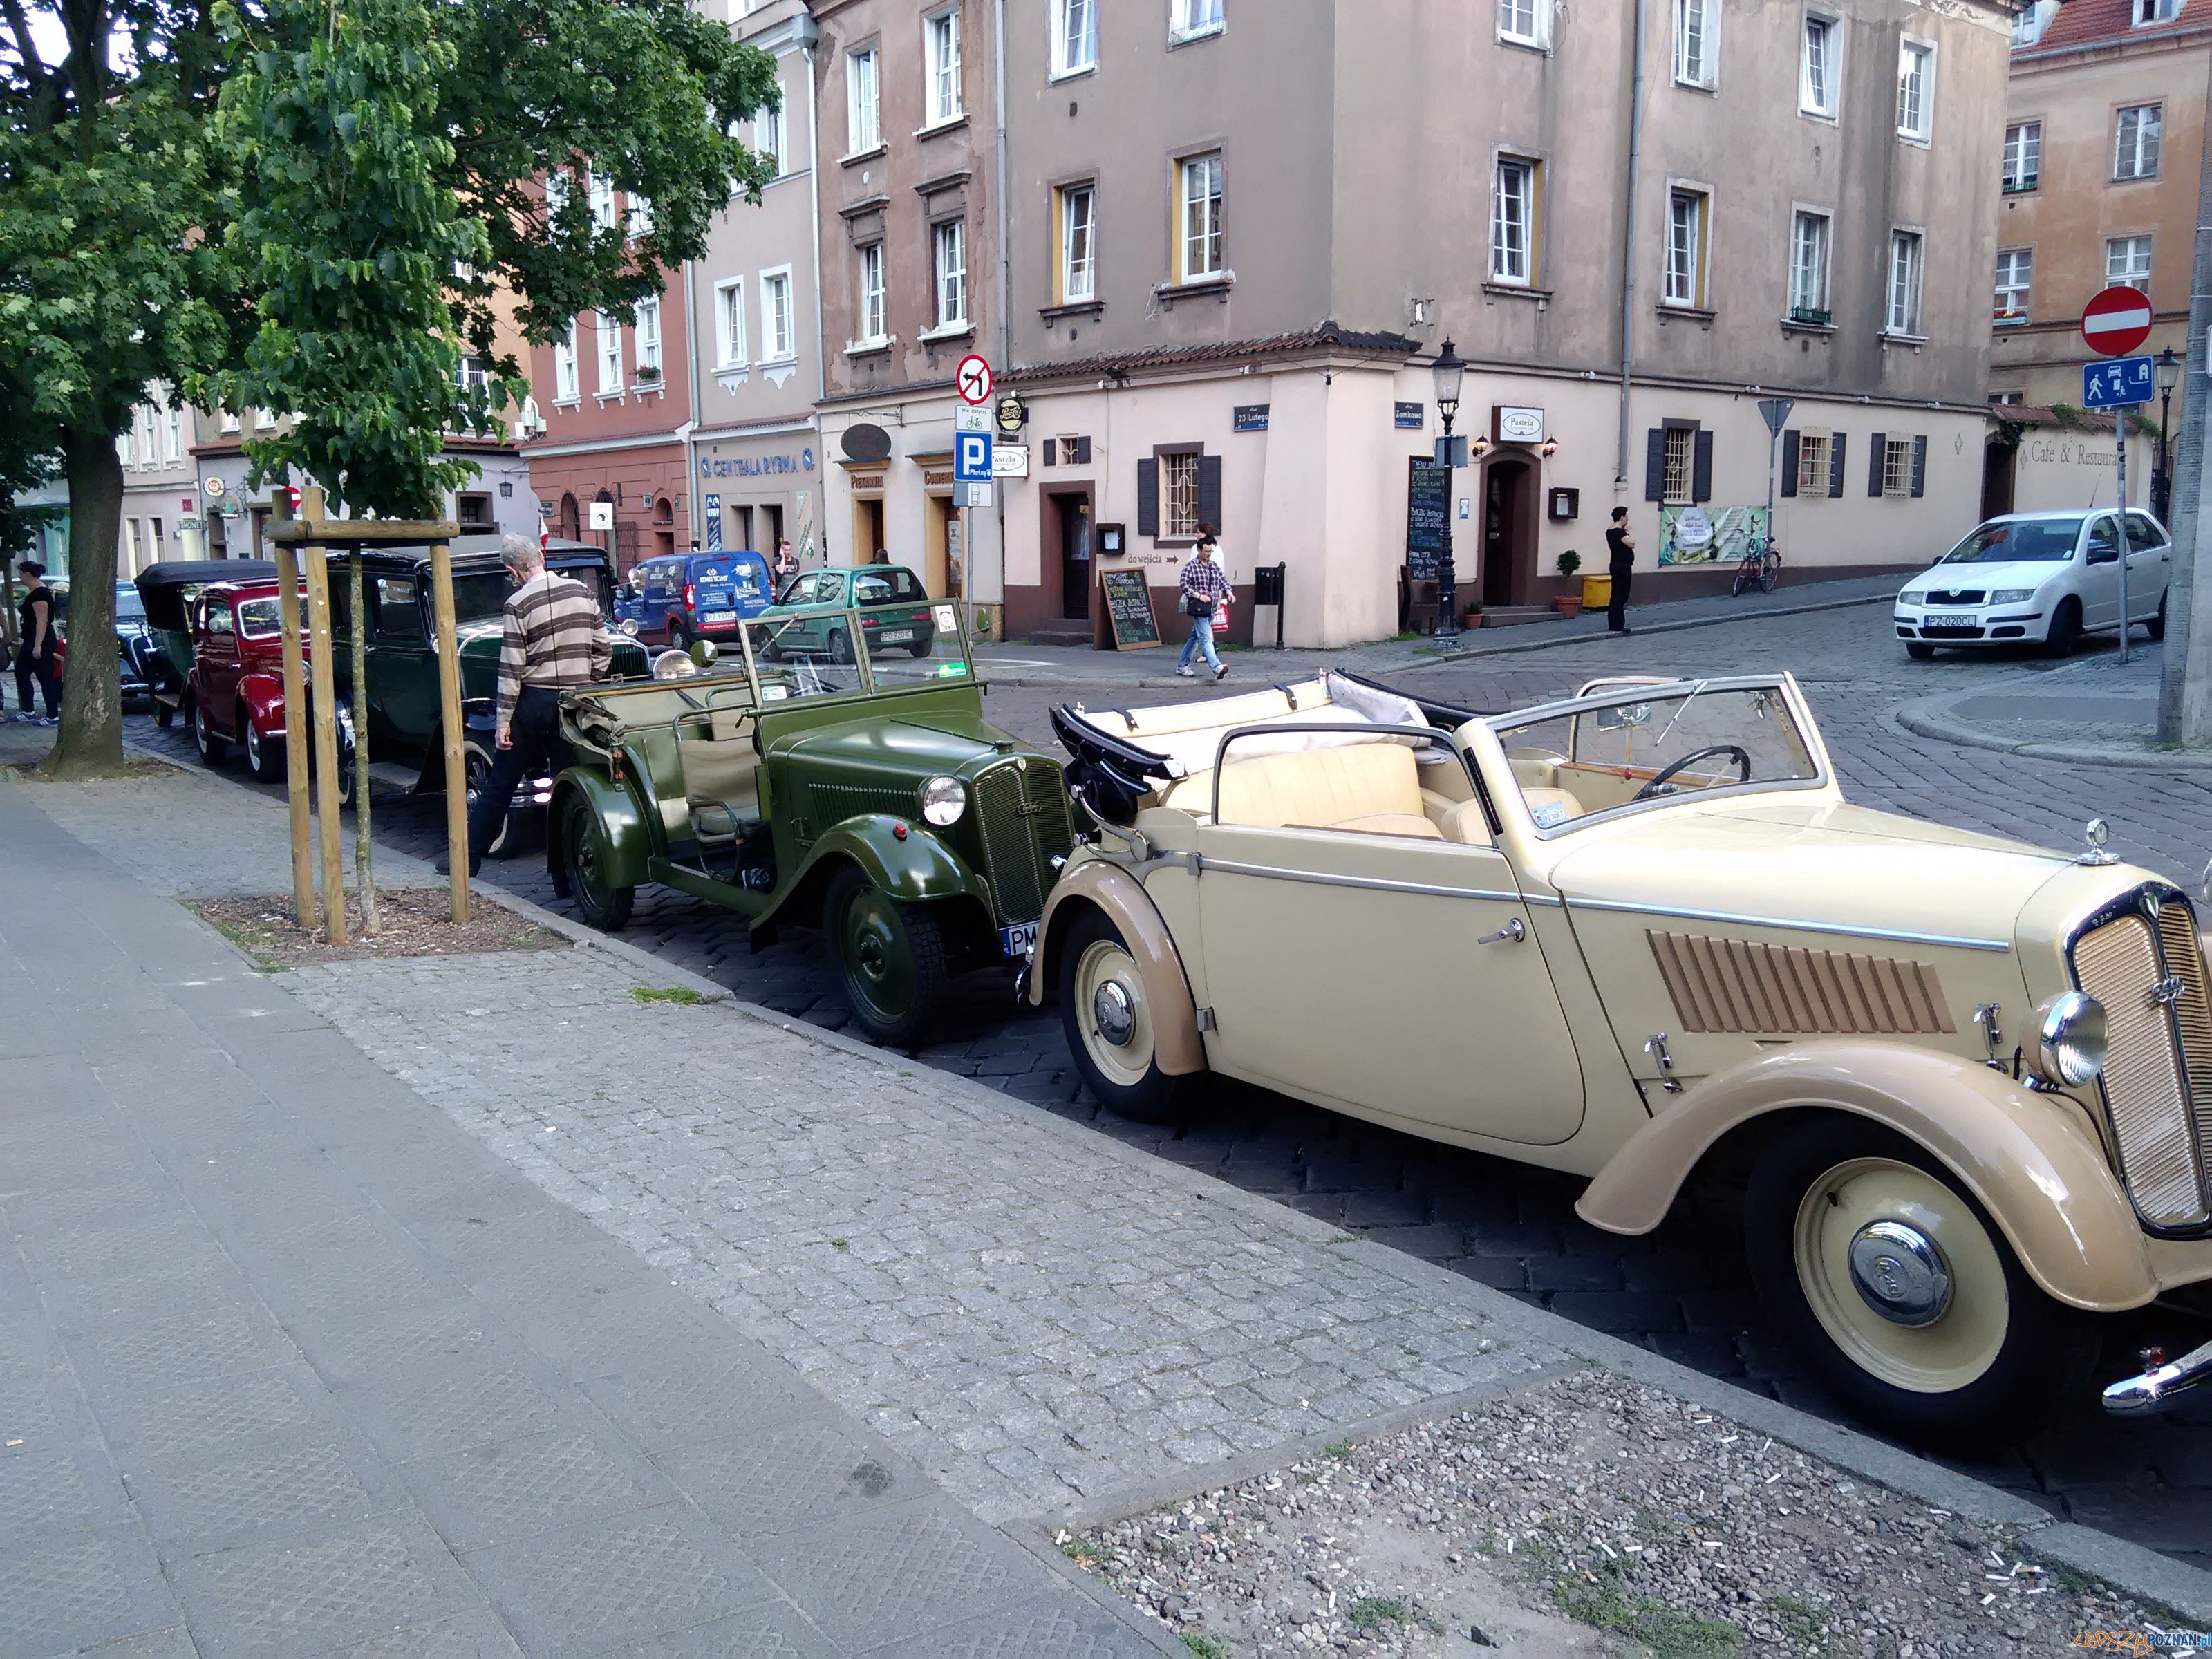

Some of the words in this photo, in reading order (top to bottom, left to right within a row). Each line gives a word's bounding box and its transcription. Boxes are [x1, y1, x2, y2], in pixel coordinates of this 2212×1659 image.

[1238, 413, 1246, 422] 23
[1248, 413, 1268, 422] Lutego
[1396, 409, 1422, 419] Zamkowa
[1510, 417, 1533, 427] Pastela
[963, 437, 984, 476] P
[2031, 440, 2055, 462] Cafe
[2061, 443, 2071, 463] &
[713, 458, 763, 477] CENTRALA
[763, 455, 799, 474] RYBNA
[924, 470, 954, 485] CUKIERN
[1128, 554, 1137, 563] do
[1138, 554, 1162, 566] wejścia
[1930, 617, 1942, 626] PZ
[1945, 617, 1973, 626] 020CL
[894, 630, 912, 639] 9204C
